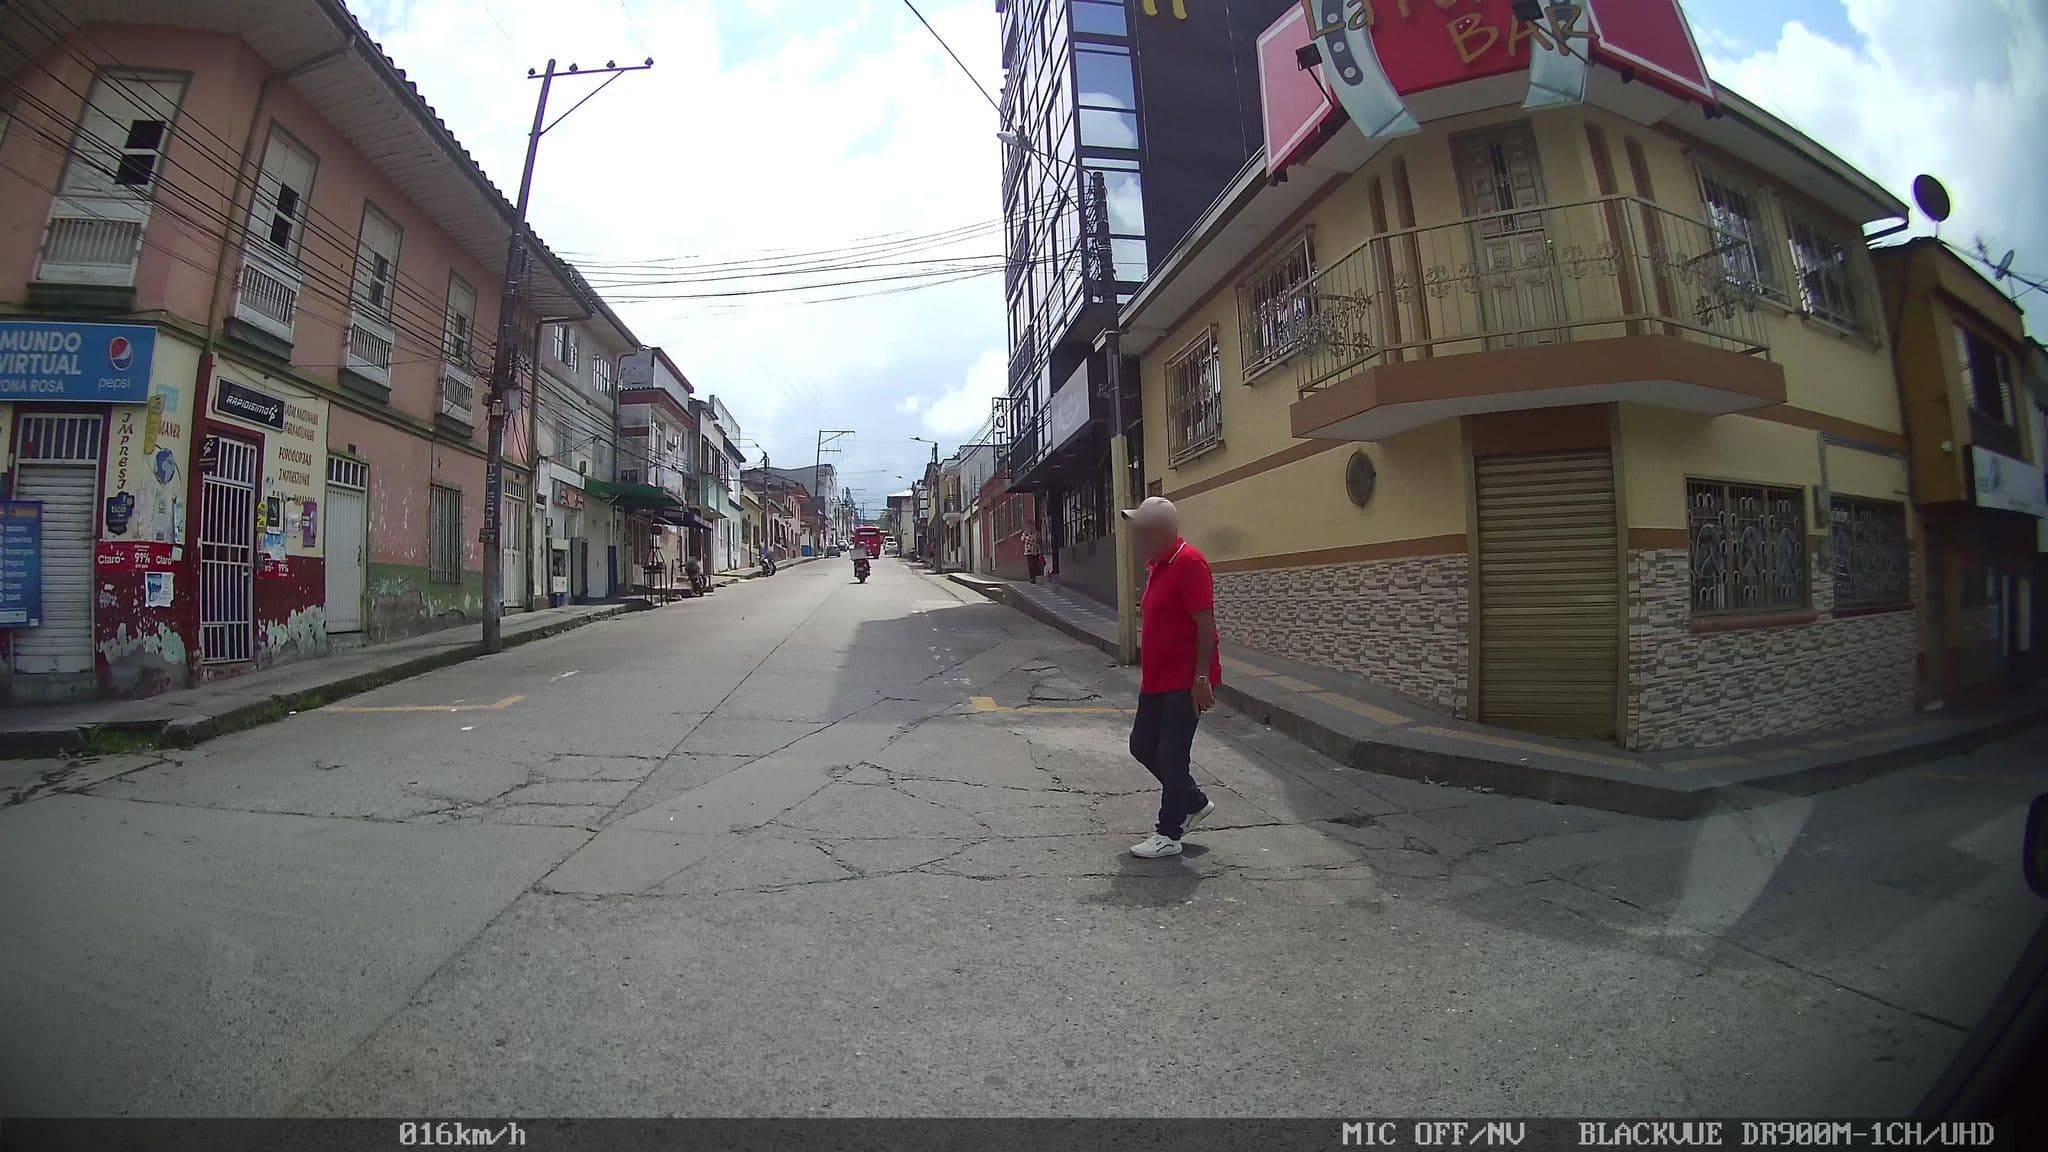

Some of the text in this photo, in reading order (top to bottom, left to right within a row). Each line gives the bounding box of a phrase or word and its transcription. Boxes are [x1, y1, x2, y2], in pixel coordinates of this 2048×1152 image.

[1447, 4, 1600, 63] BAR
[0, 331, 82, 352] MUNDO
[0, 379, 64, 393] ONA ROSA
[98, 376, 131, 391] pepsi
[97, 550, 121, 565] Claro
